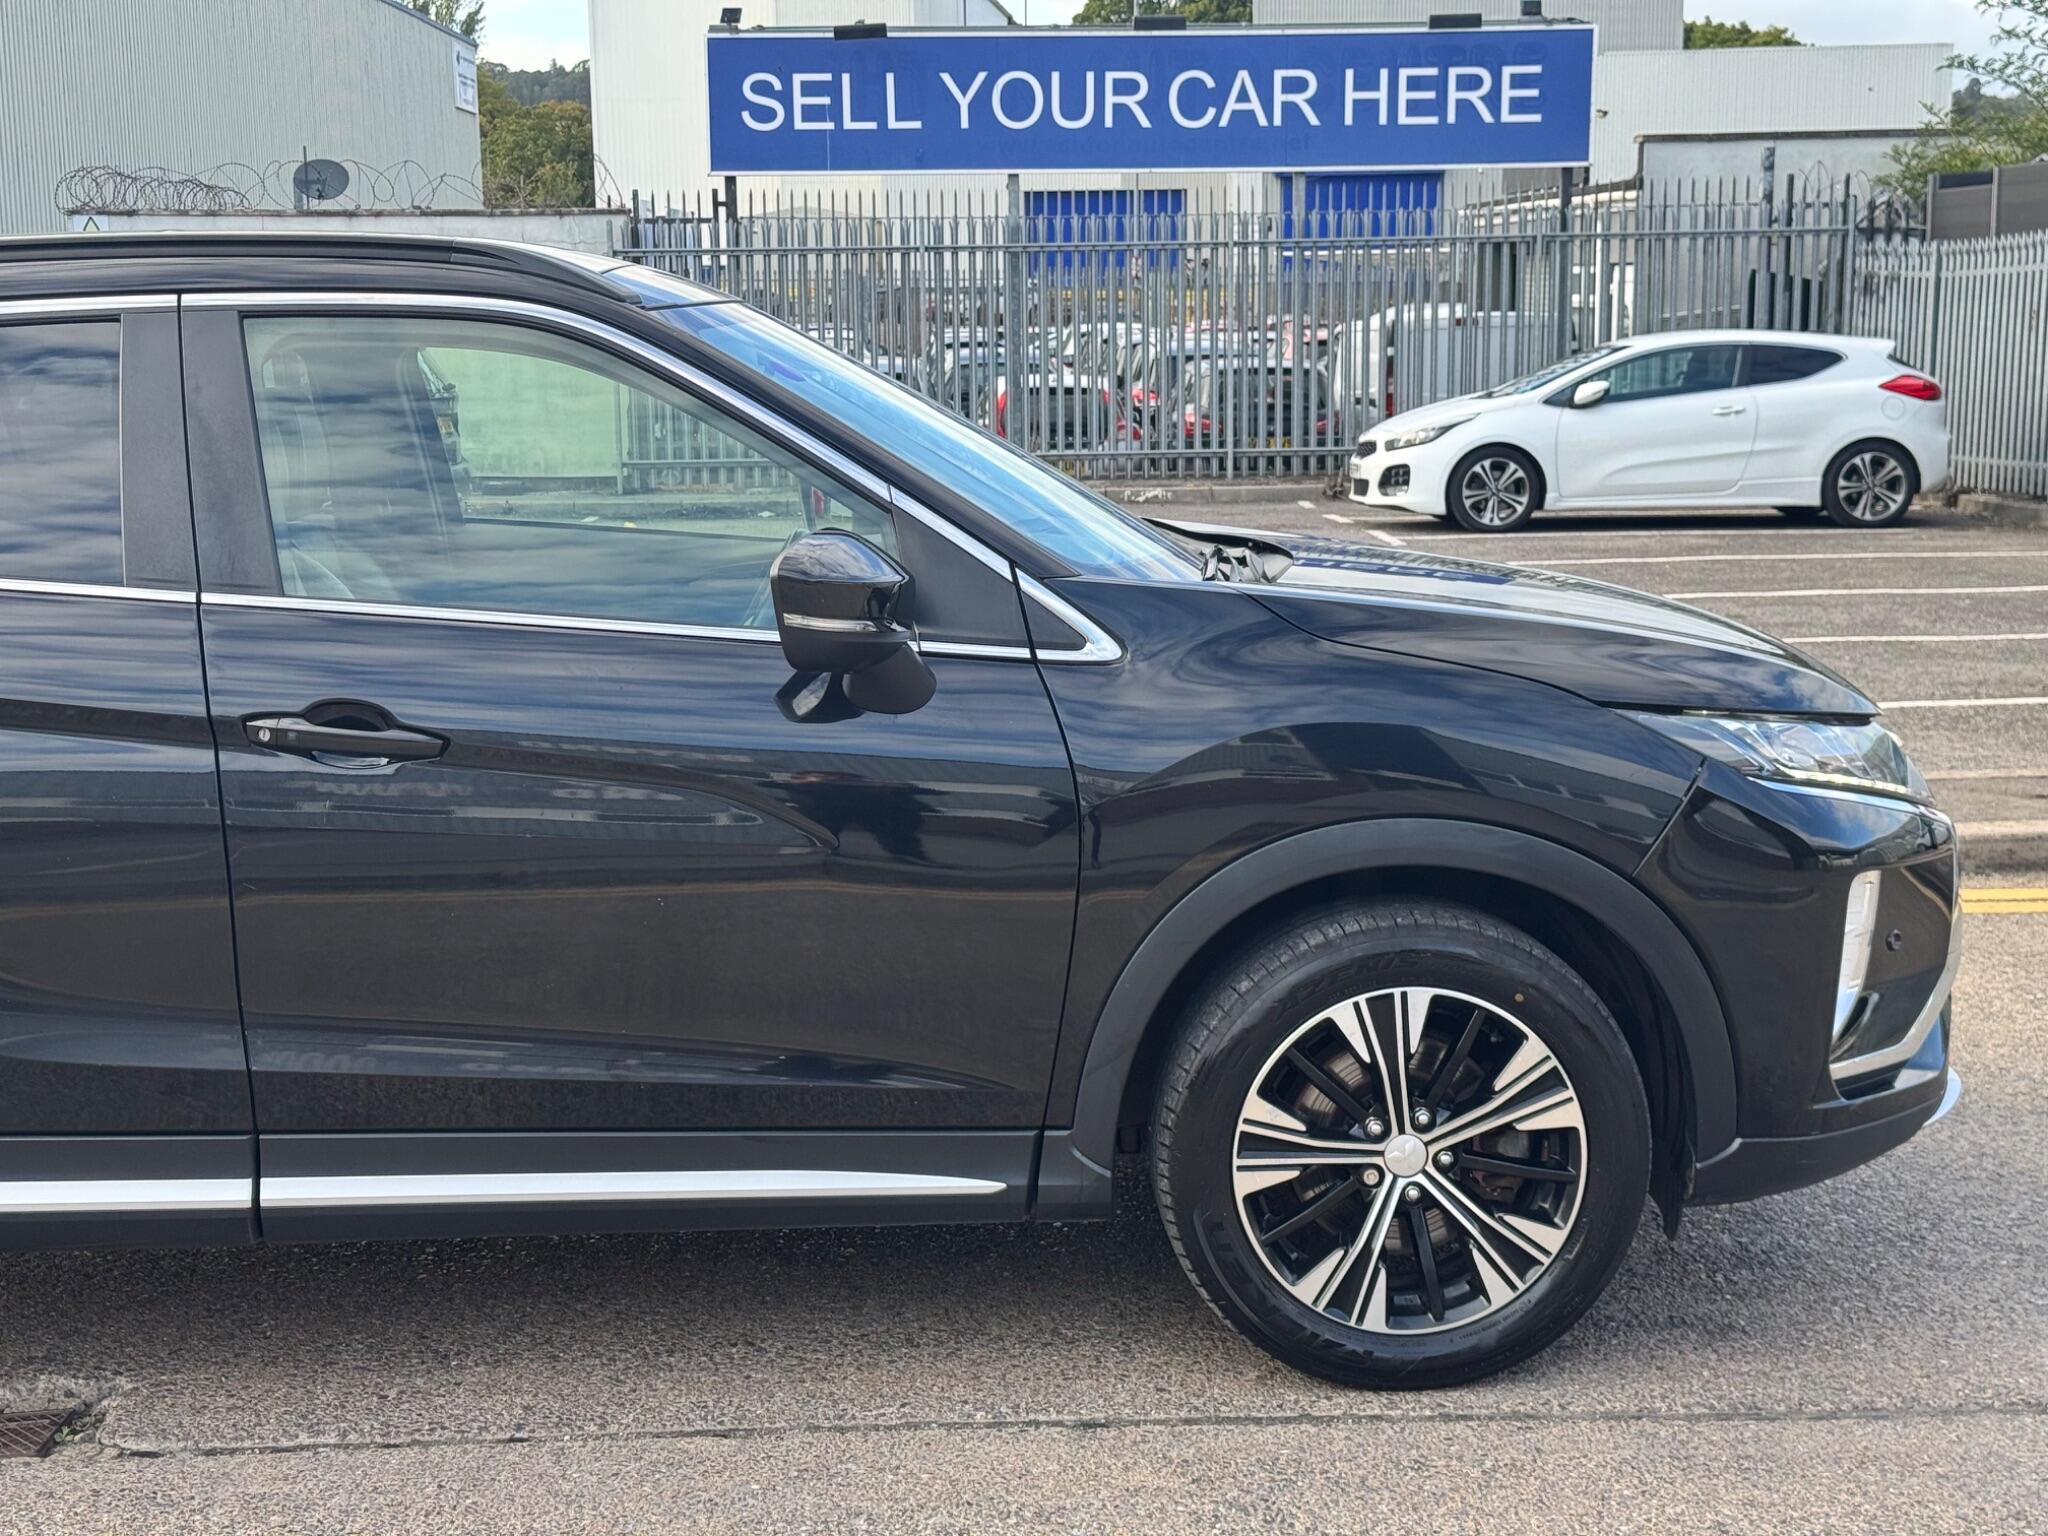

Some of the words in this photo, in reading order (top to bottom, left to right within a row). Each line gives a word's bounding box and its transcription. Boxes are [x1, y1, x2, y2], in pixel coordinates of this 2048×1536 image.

[741, 72, 923, 132] SELL
[939, 70, 1153, 130] YOUR
[1168, 68, 1321, 129] CAR
[1344, 64, 1543, 126] HERE
